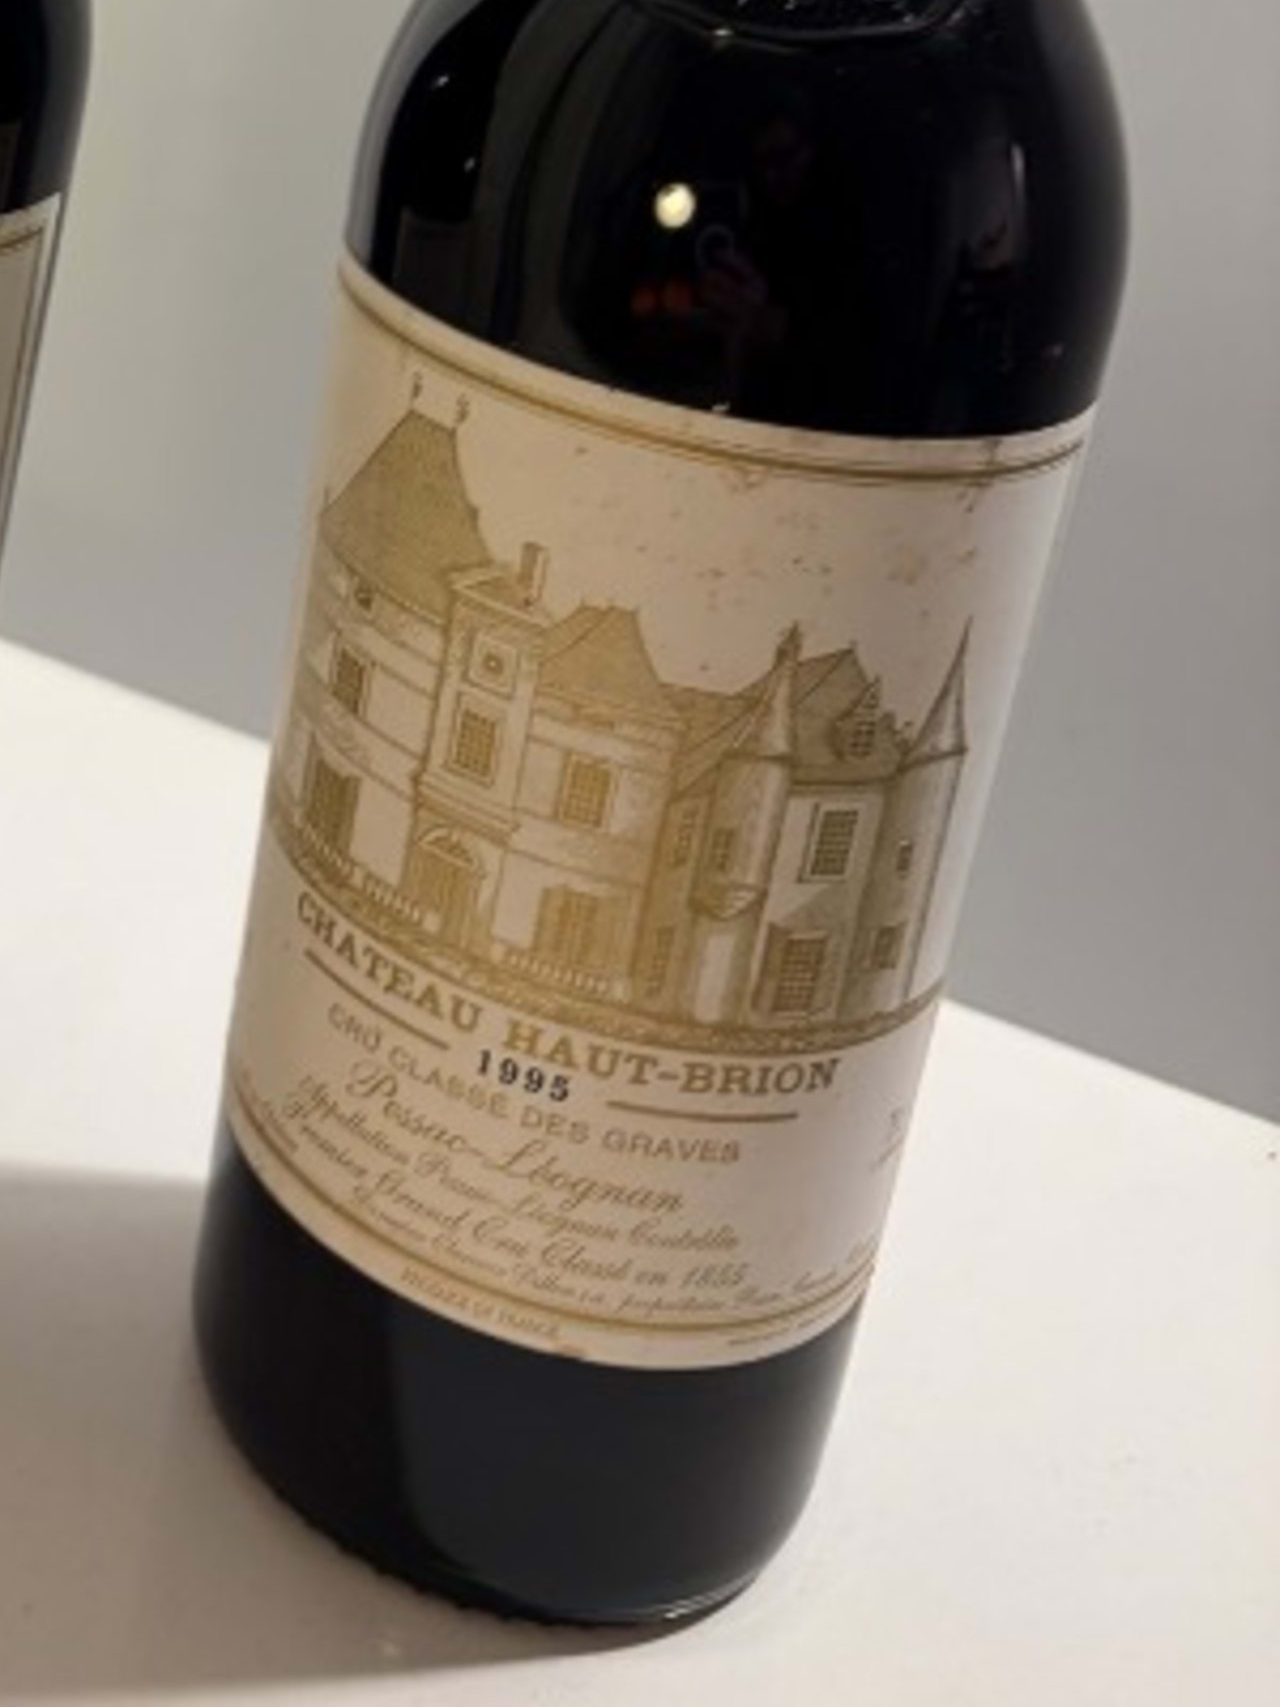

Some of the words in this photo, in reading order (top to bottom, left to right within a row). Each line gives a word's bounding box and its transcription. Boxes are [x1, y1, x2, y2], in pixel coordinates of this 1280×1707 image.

[297, 891, 484, 1034] CHATEAU
[502, 1020, 842, 1096] HAUT-BRION
[477, 1048, 571, 1102] 1995
[520, 1105, 590, 1145] DES
[601, 1128, 741, 1165] GRAVES
[679, 1261, 750, 1289] 1855
